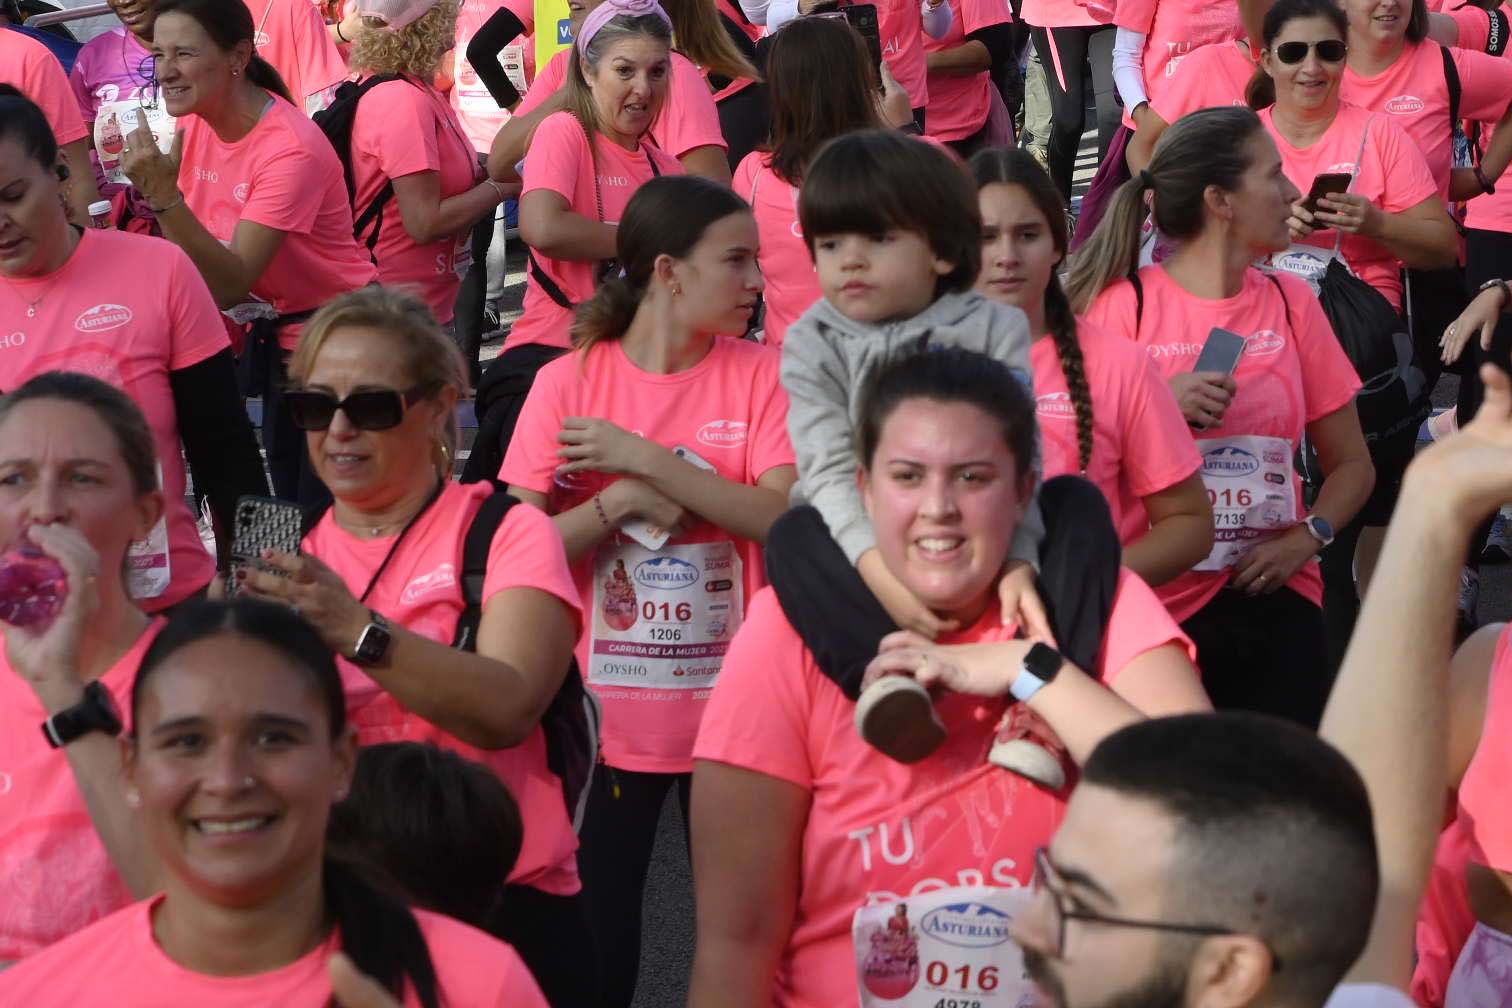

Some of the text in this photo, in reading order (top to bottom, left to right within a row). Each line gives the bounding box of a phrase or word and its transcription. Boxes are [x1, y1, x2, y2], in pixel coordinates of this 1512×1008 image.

[639, 568, 695, 583] ASTURIANA
[642, 600, 693, 623] 016
[649, 628, 682, 642] 1206
[608, 644, 648, 654] CARRERA
[648, 646, 661, 655] DE
[662, 647, 674, 655] LA
[676, 645, 707, 655] MUJER
[604, 662, 722, 677] OYSHO Santan
[848, 818, 915, 872] TU
[926, 960, 1000, 991] 016
